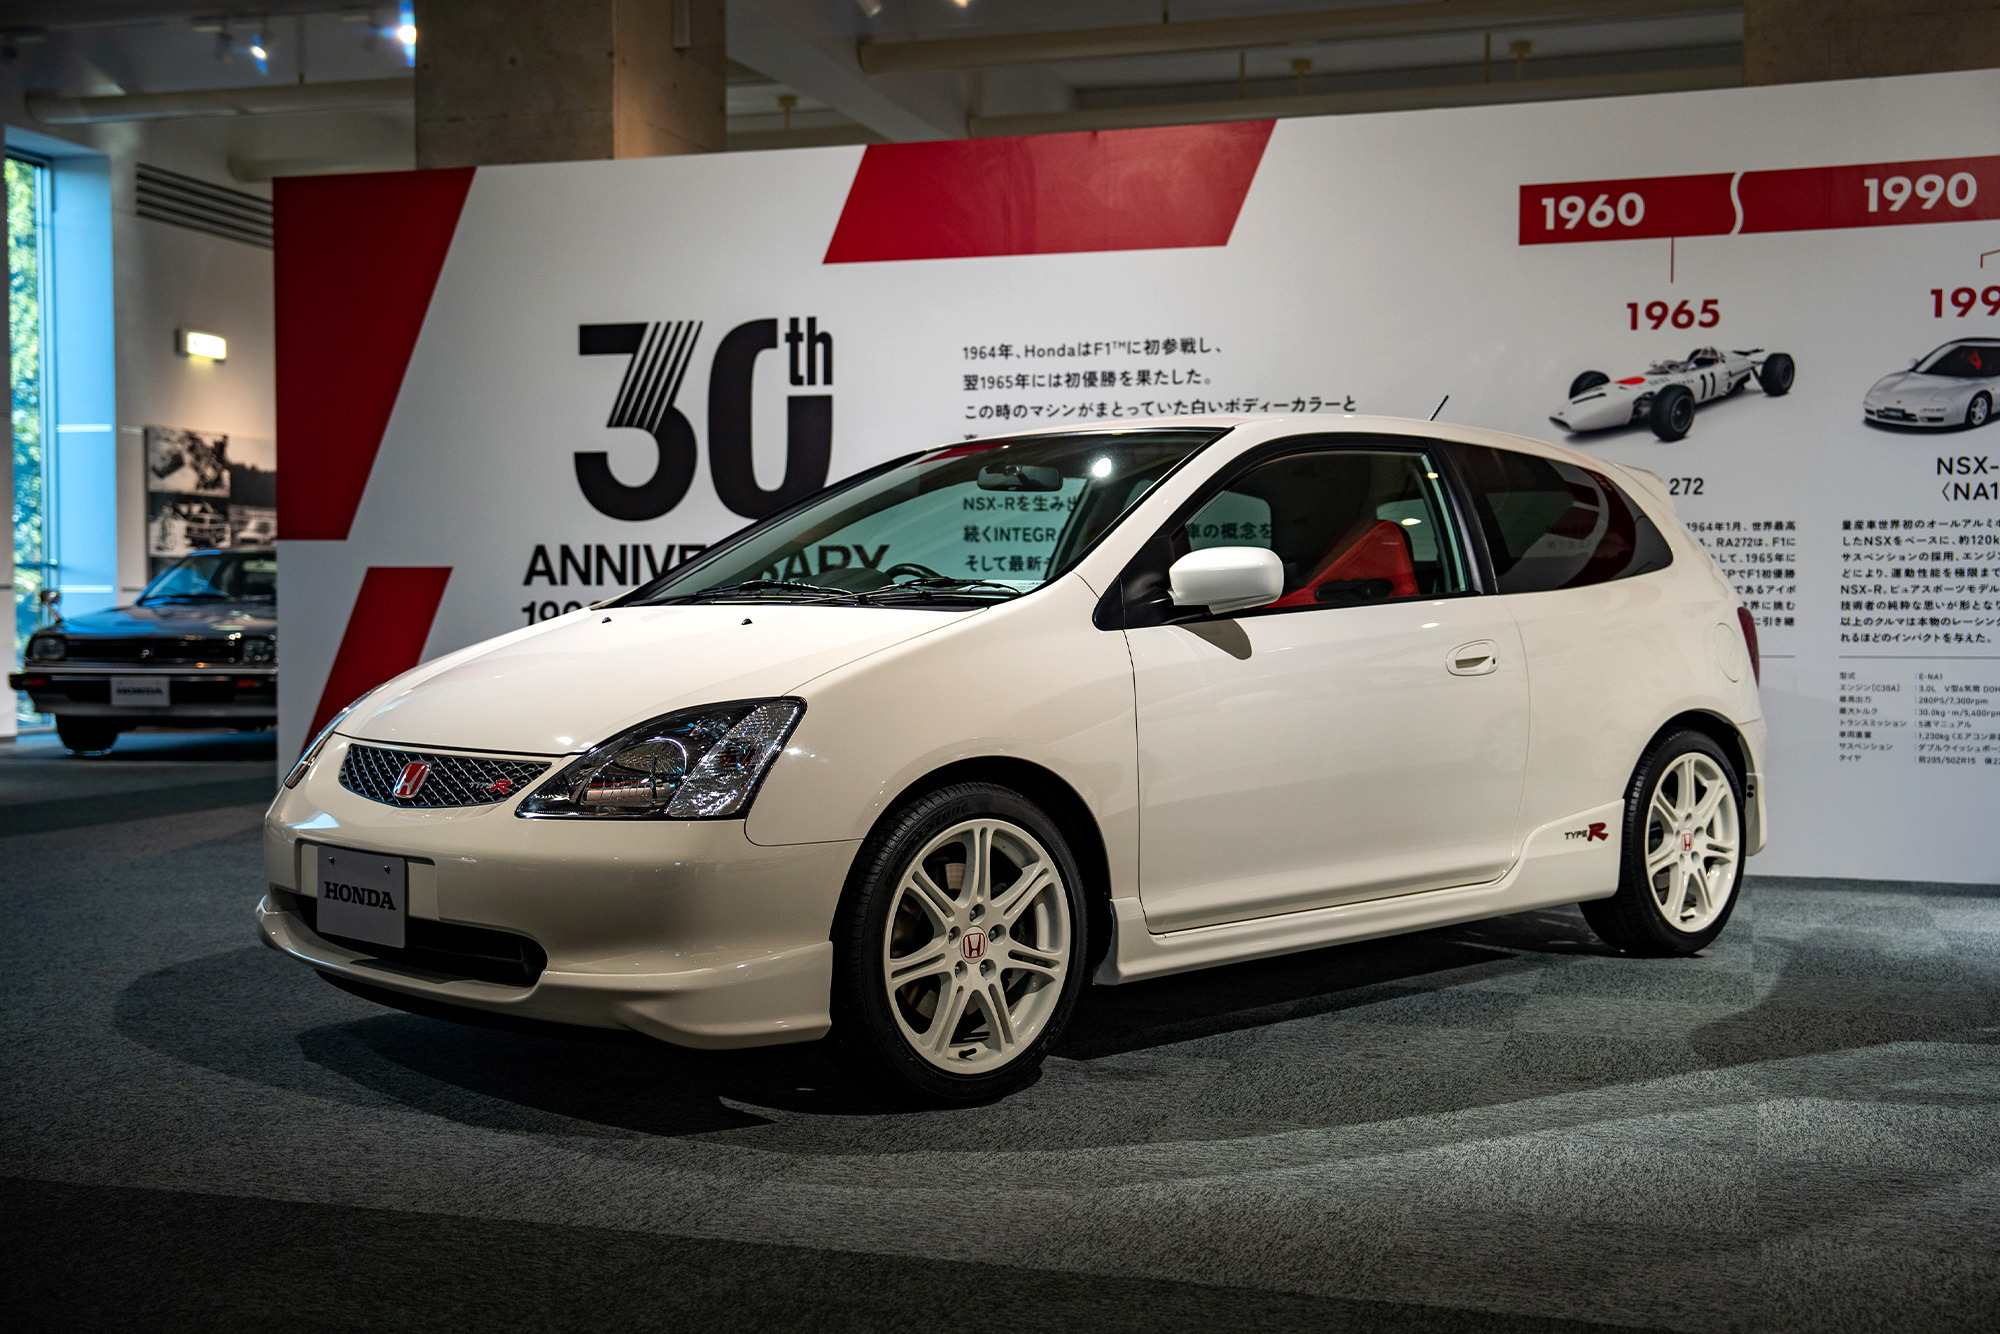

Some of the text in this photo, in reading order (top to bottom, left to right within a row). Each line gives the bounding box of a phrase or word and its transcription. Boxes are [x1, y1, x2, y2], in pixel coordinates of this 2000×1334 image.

[1863, 172, 1978, 213] 1990
[1541, 192, 1646, 230] 1960
[1626, 298, 1721, 331] 1965
[963, 368, 1212, 391] 翌1965年には初優勝を果たした。
[1670, 478, 1703, 495] 272
[1843, 551, 2000, 562] サスペンションの採用、エンジ
[1564, 822, 1608, 842] TYPE R
[324, 881, 397, 911] HONDA
